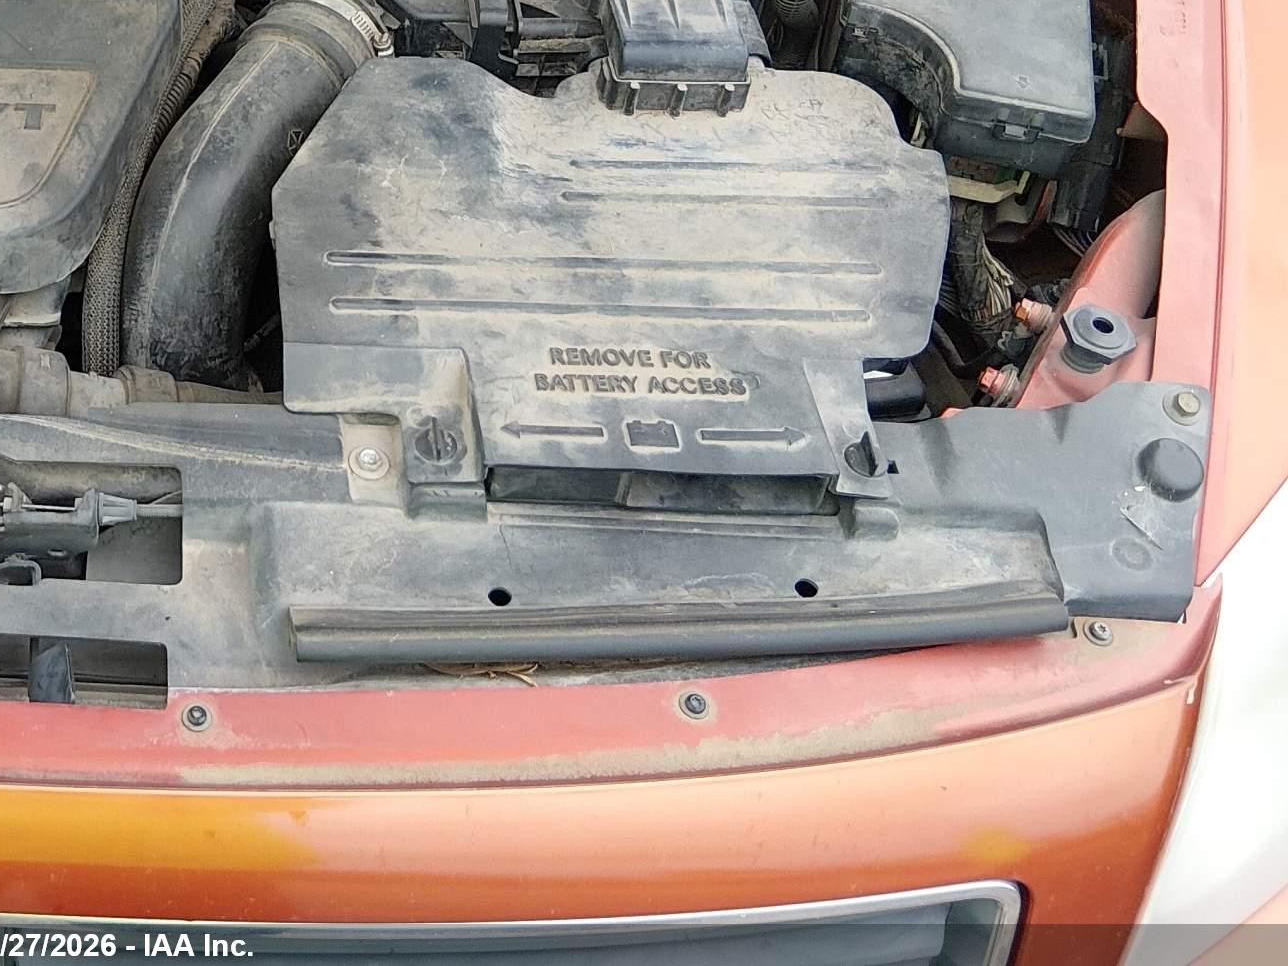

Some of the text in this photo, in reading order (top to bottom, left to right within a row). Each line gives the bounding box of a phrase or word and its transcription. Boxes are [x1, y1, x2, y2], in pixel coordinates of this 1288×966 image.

[549, 346, 712, 370] REMOVE FOR
[534, 372, 748, 397] BATTERY ACCESS
